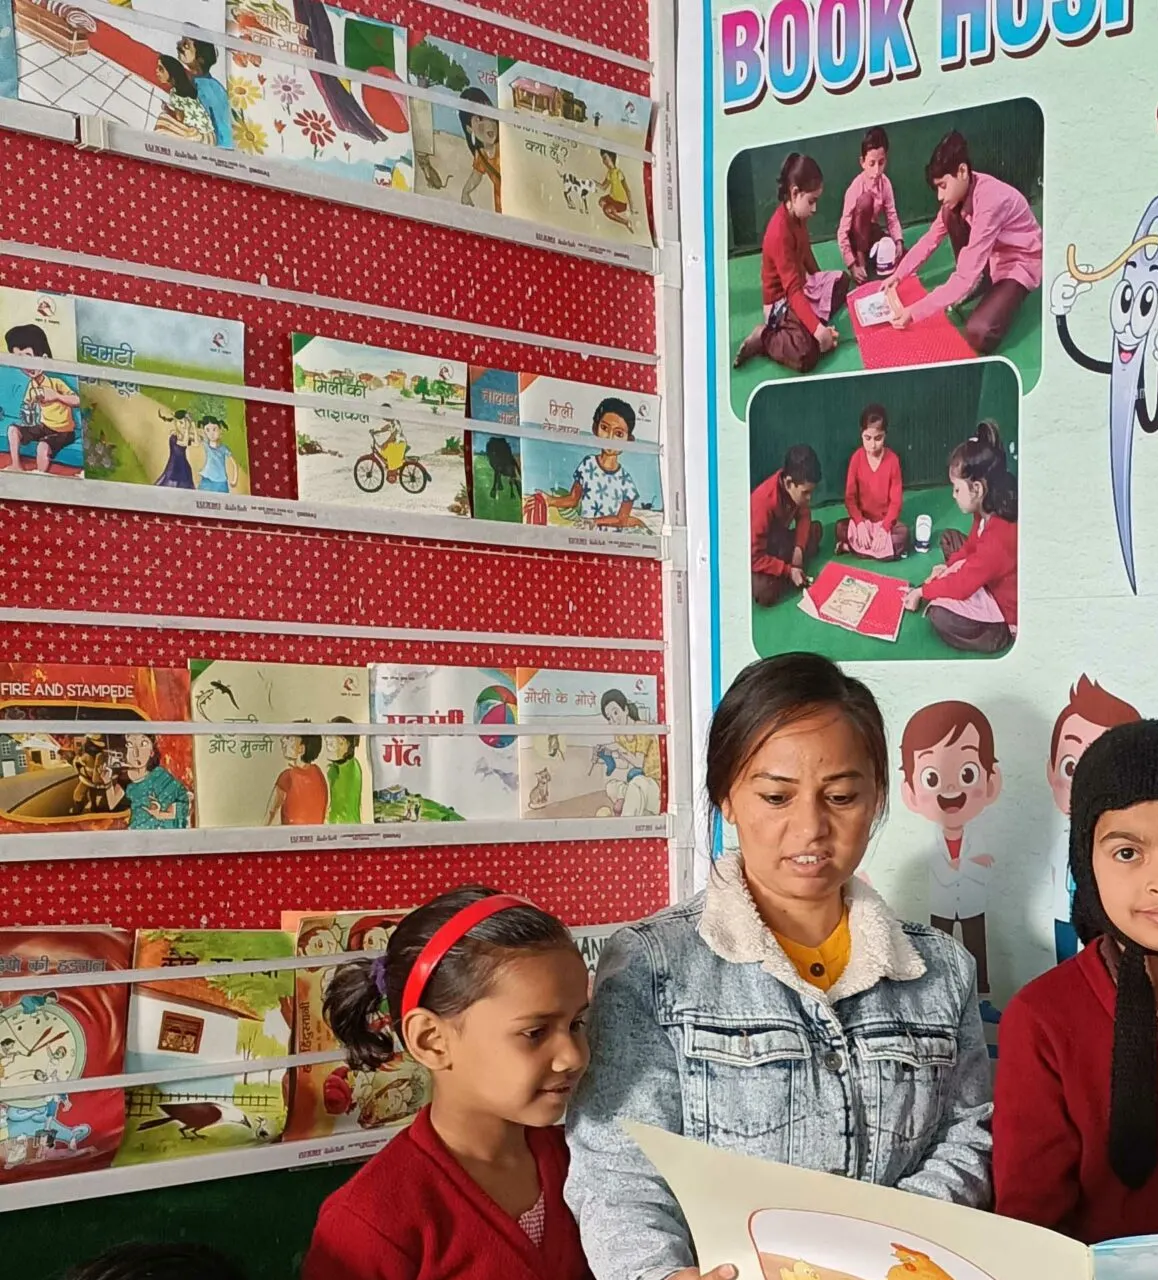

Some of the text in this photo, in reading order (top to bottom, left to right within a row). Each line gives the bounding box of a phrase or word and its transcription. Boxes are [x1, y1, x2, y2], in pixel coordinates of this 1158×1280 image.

[721, 0, 920, 114] BOOK
[524, 139, 547, 156] क्या
[81, 336, 135, 366] चिमटी
[313, 376, 367, 398] मिली की
[549, 399, 575, 419] मिली
[1, 683, 134, 699] FIRE AND STAMPEDE
[555, 688, 568, 705] के
[208, 733, 274, 758] और मुन्नी
[382, 737, 422, 767] गेंद
